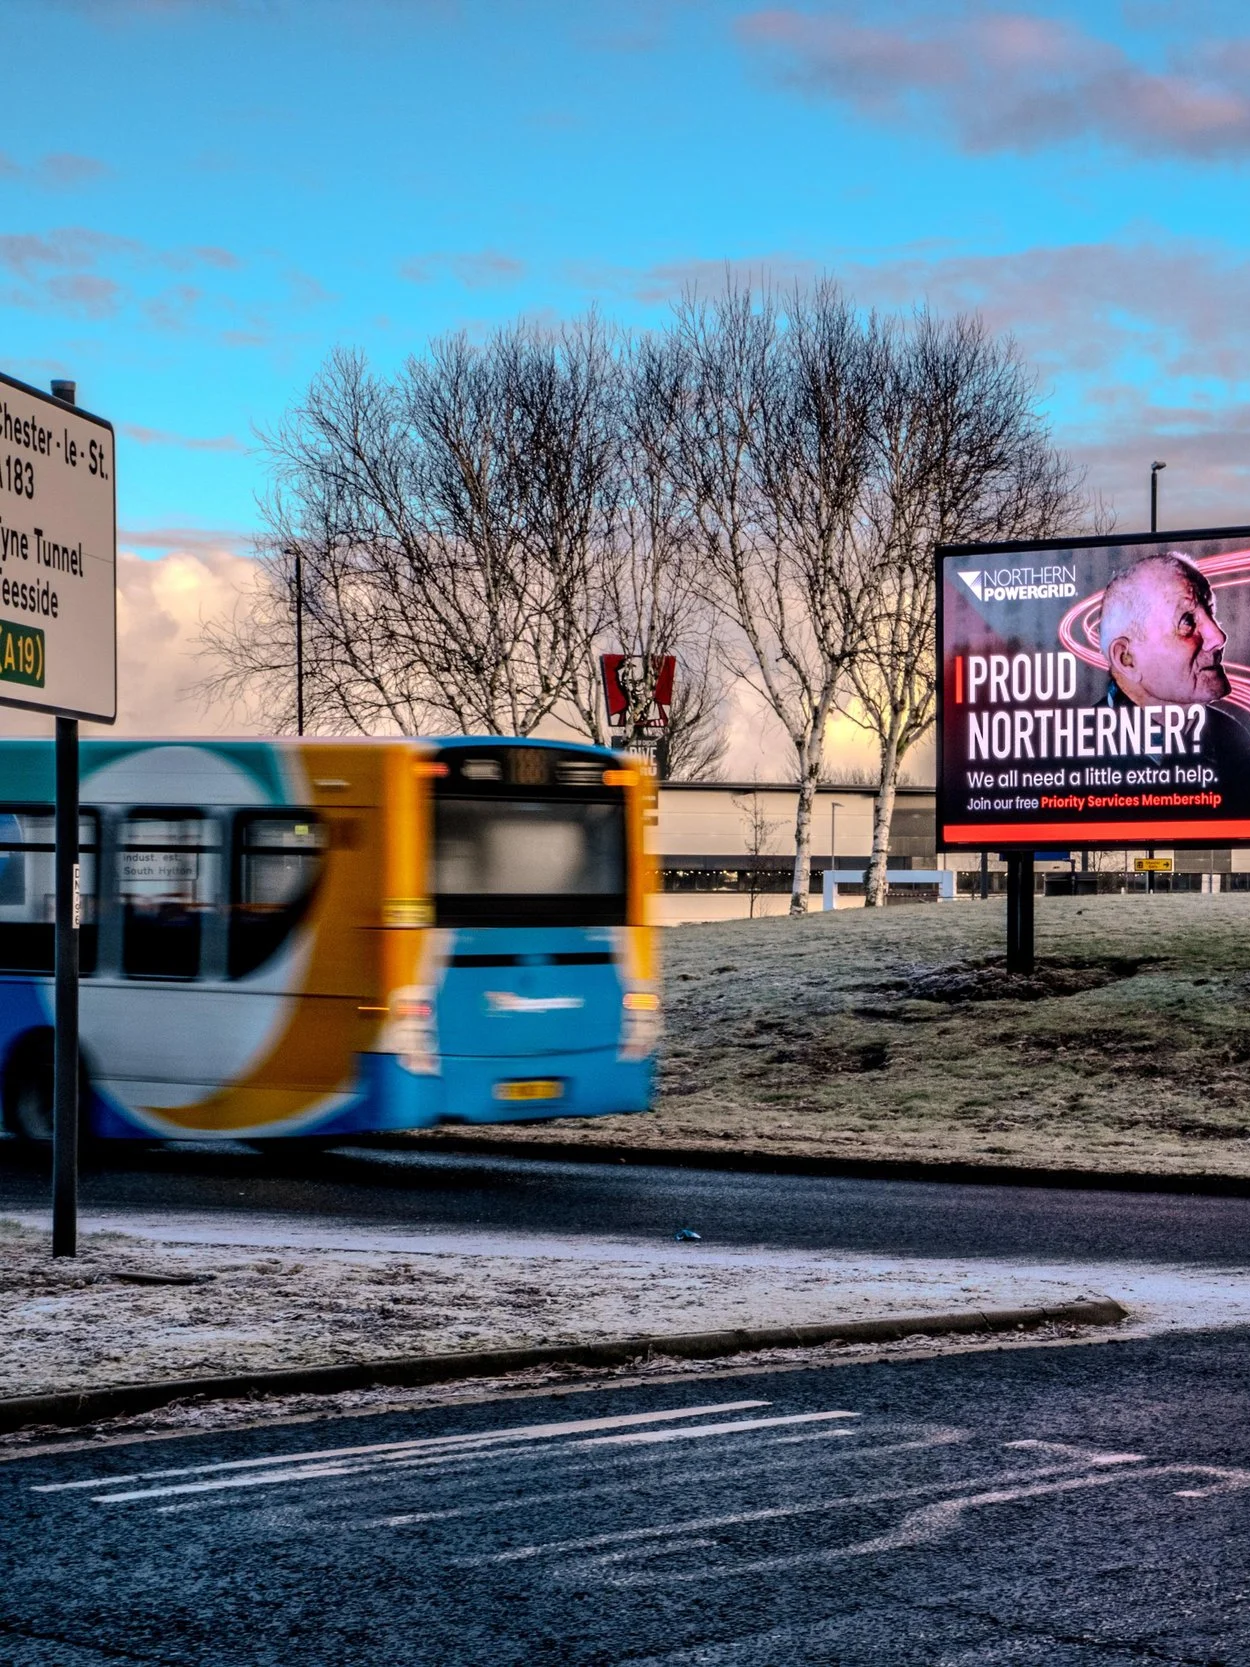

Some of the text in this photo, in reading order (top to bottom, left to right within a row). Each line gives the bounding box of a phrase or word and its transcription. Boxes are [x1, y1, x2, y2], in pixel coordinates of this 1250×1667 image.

[0, 516, 83, 577] yne Tunnel
[984, 565, 1076, 587] NORTHERN
[0, 567, 58, 618] eesside
[984, 583, 1077, 602] POWERGRID
[969, 651, 1077, 704] PROUD
[968, 704, 1206, 760] NORTHERNER?
[967, 765, 1219, 789] We all need a little extra help.
[967, 791, 1222, 812] Join our free Priority Services Membership
[124, 866, 193, 877] South Hylton
